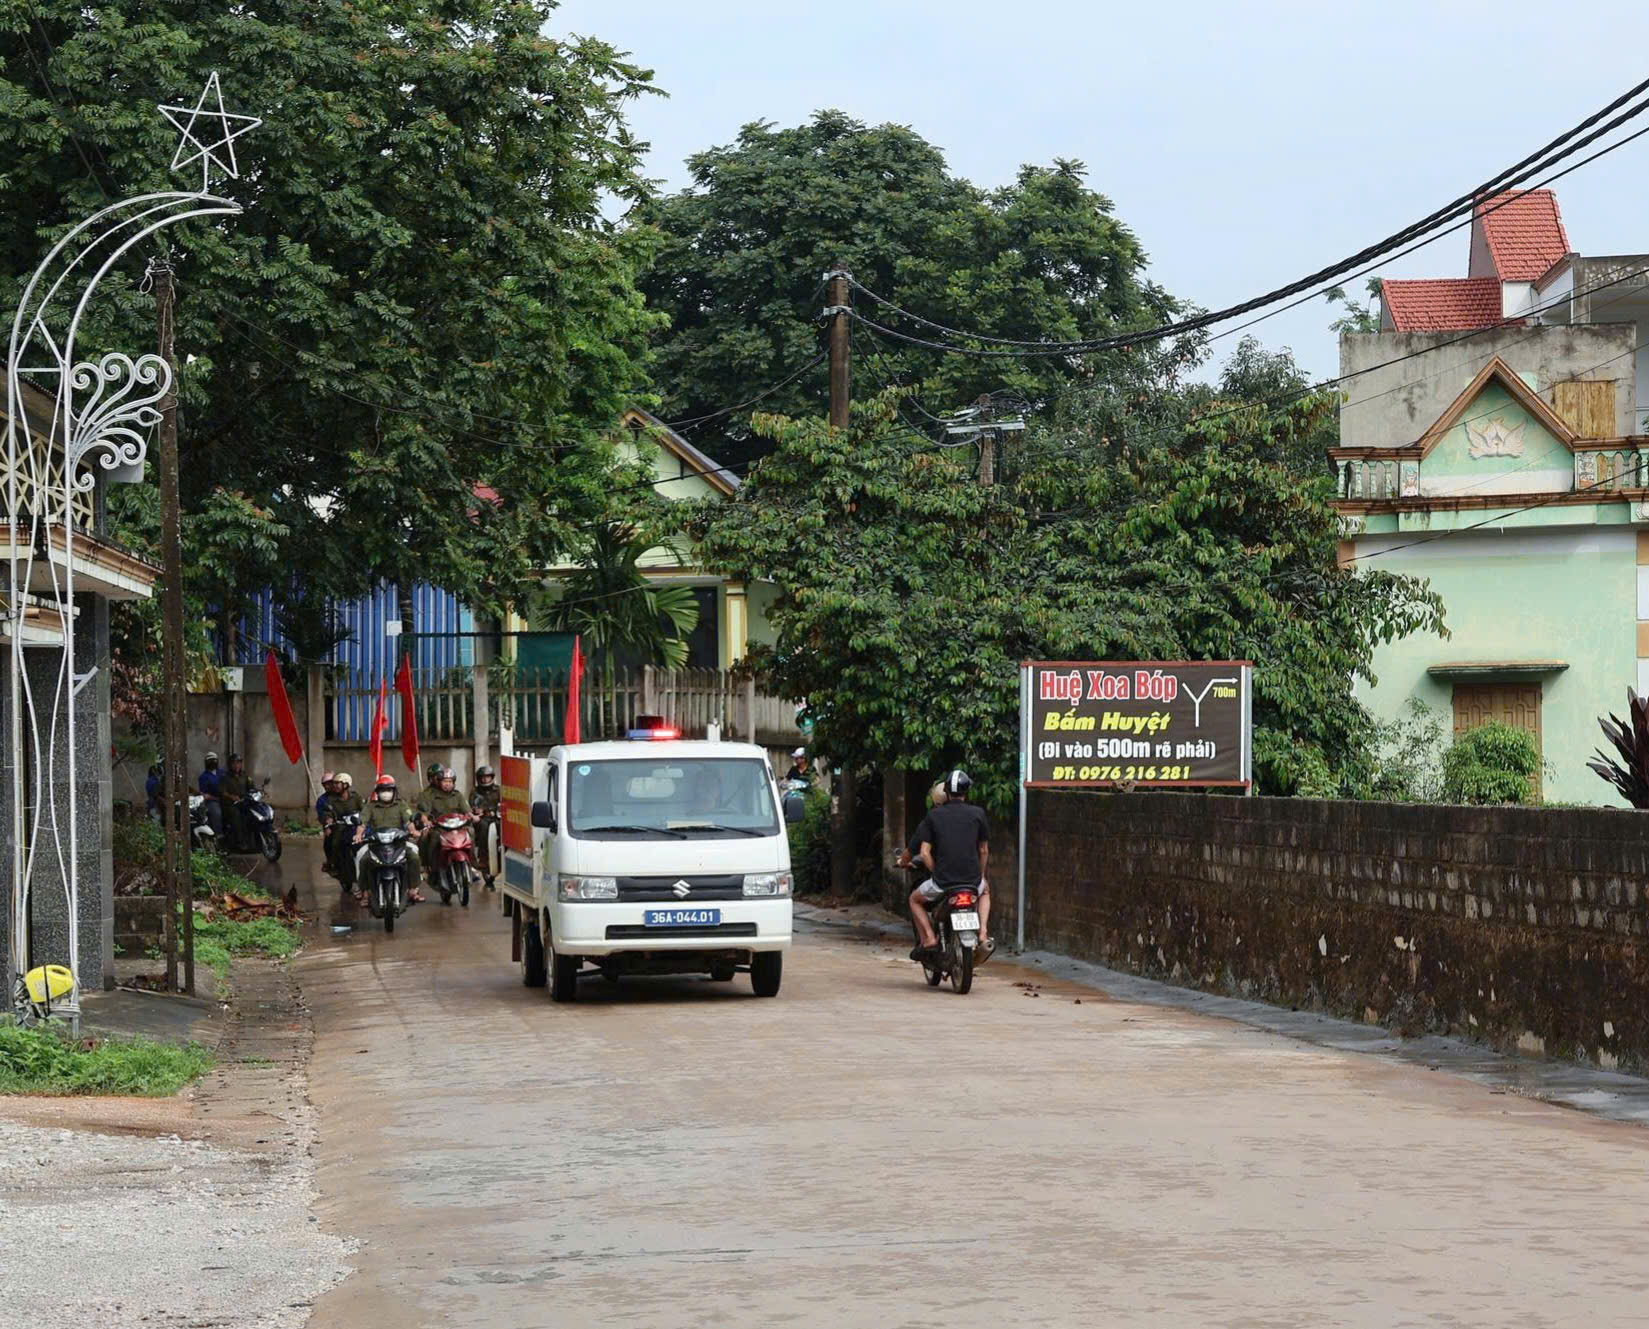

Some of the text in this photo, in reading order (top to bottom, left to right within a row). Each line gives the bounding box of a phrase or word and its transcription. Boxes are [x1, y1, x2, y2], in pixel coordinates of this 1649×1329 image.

[1040, 670, 1177, 705] Huệ Xoa Bóp
[1212, 687, 1236, 698] 700m
[1044, 708, 1170, 735] Bấm Huyệt
[1039, 738, 1216, 760] (Đi vào 500m rẽ phải)
[1053, 766, 1190, 780] ĐT: 0976 216 281
